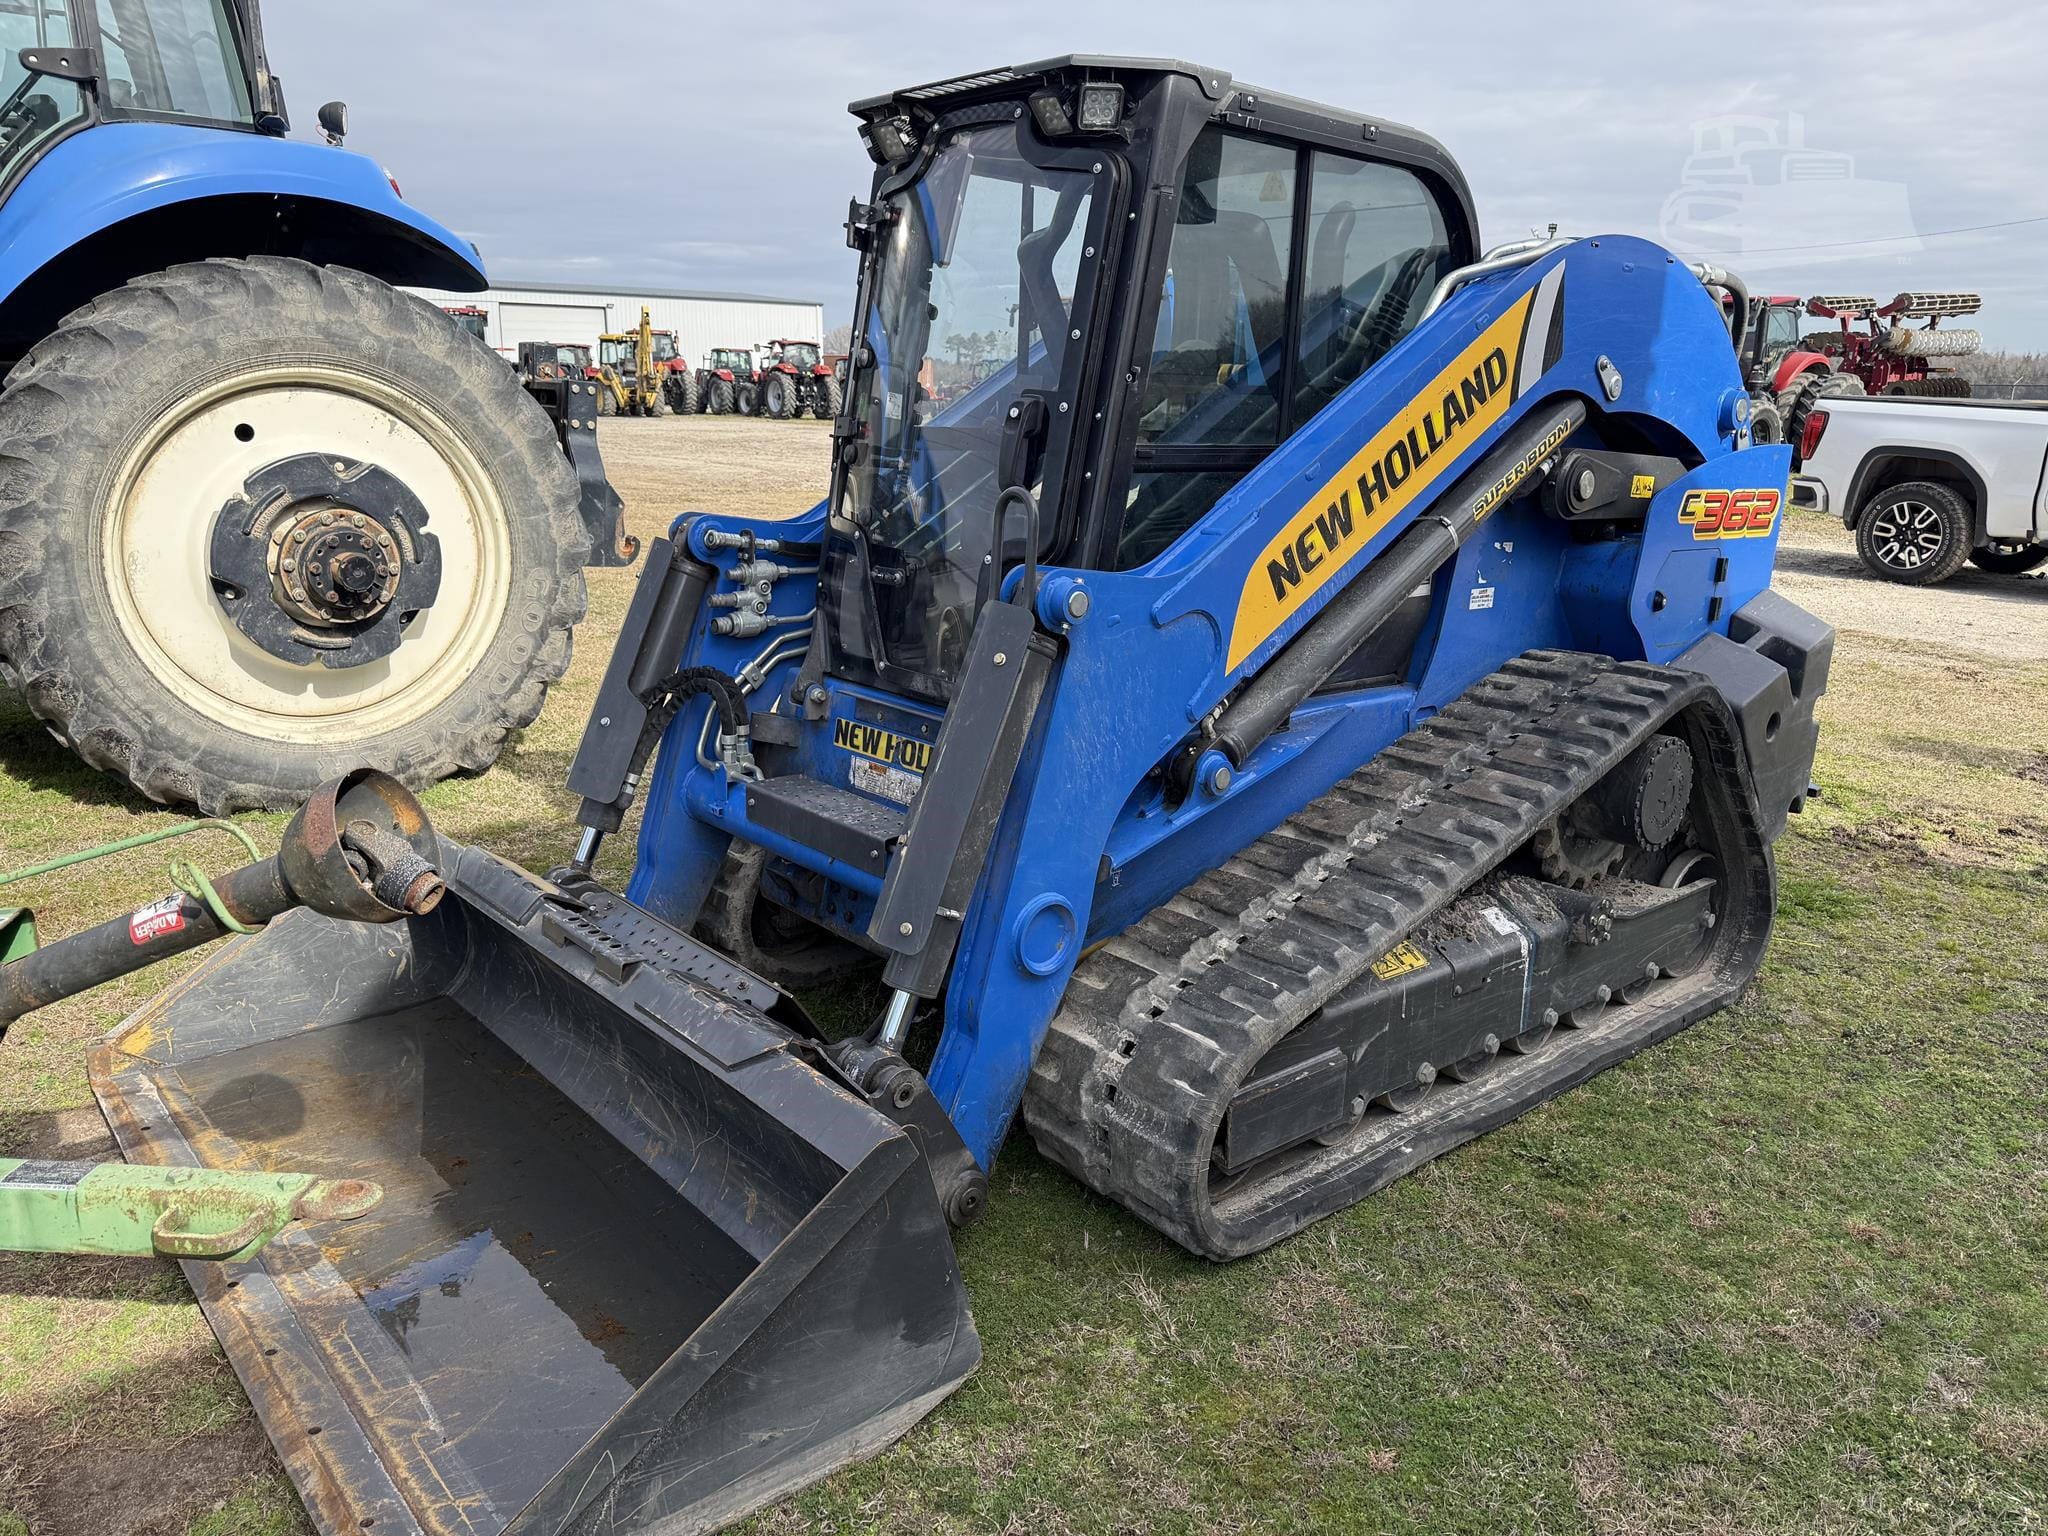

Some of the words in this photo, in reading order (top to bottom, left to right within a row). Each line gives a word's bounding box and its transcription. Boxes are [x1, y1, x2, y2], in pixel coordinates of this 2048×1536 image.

[1267, 489, 1354, 602] NEW
[1357, 347, 1508, 518] HOLLAND
[1473, 461, 1526, 520] SUPER
[1526, 418, 1570, 471] BOOM
[1679, 489, 1780, 538] C362
[318, 567, 550, 784] GOODYEAR
[834, 718, 882, 757] NEW
